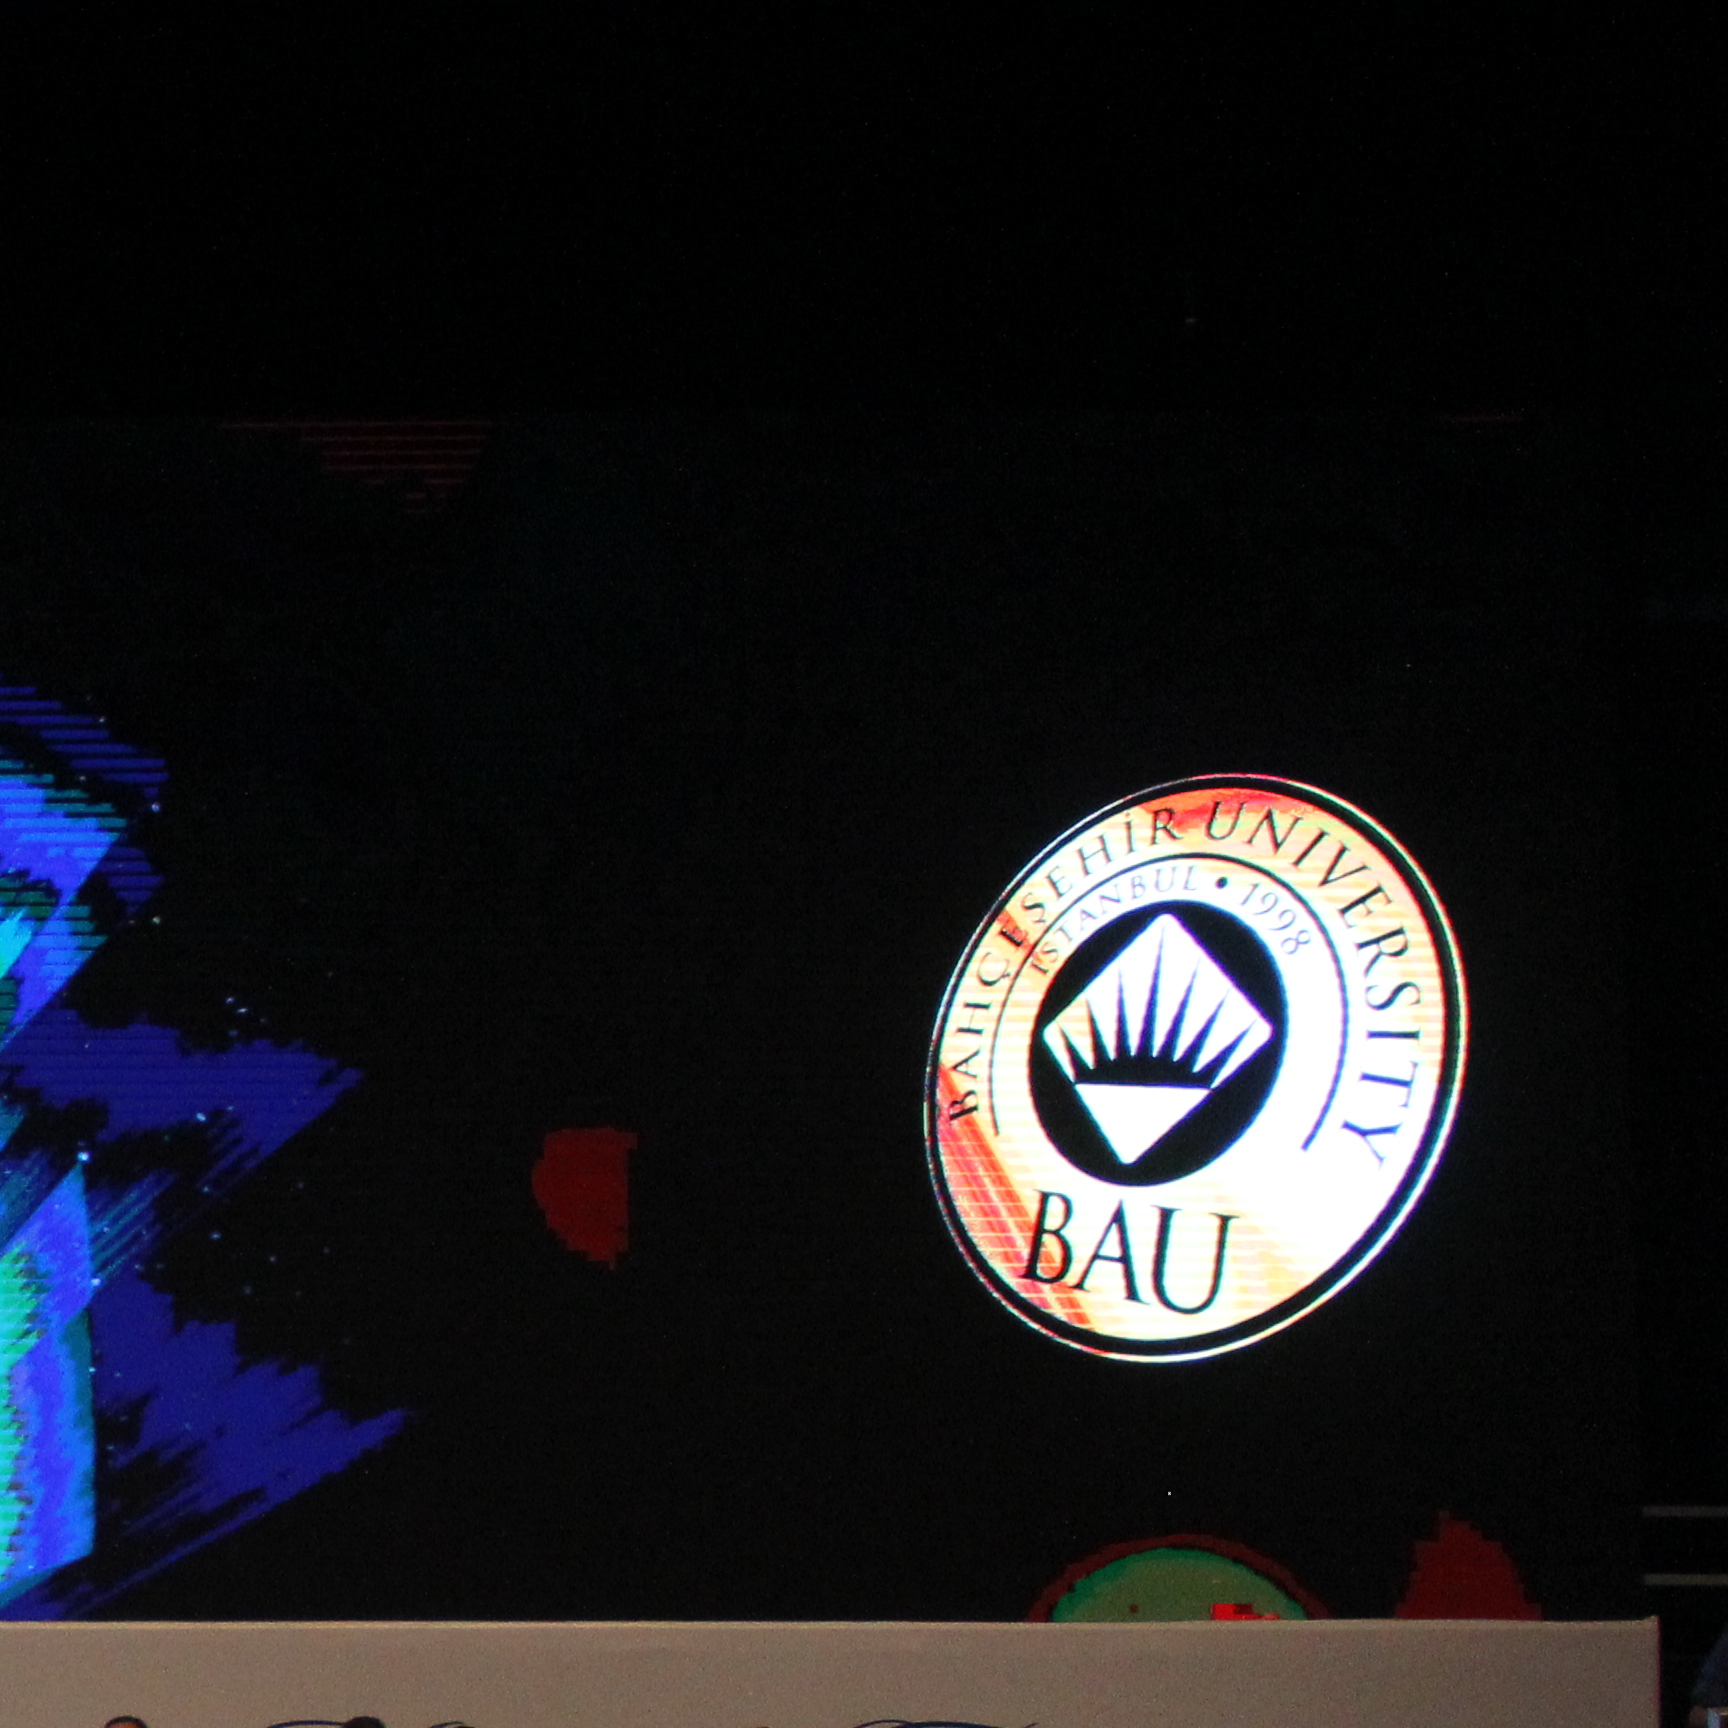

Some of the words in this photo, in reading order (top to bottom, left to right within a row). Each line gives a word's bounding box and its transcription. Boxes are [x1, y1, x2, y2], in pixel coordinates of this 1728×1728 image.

[1239, 881, 1312, 956] 1998
[1203, 800, 1423, 1170] UNIVERSITY
[1021, 1188, 1240, 1315] BAU
